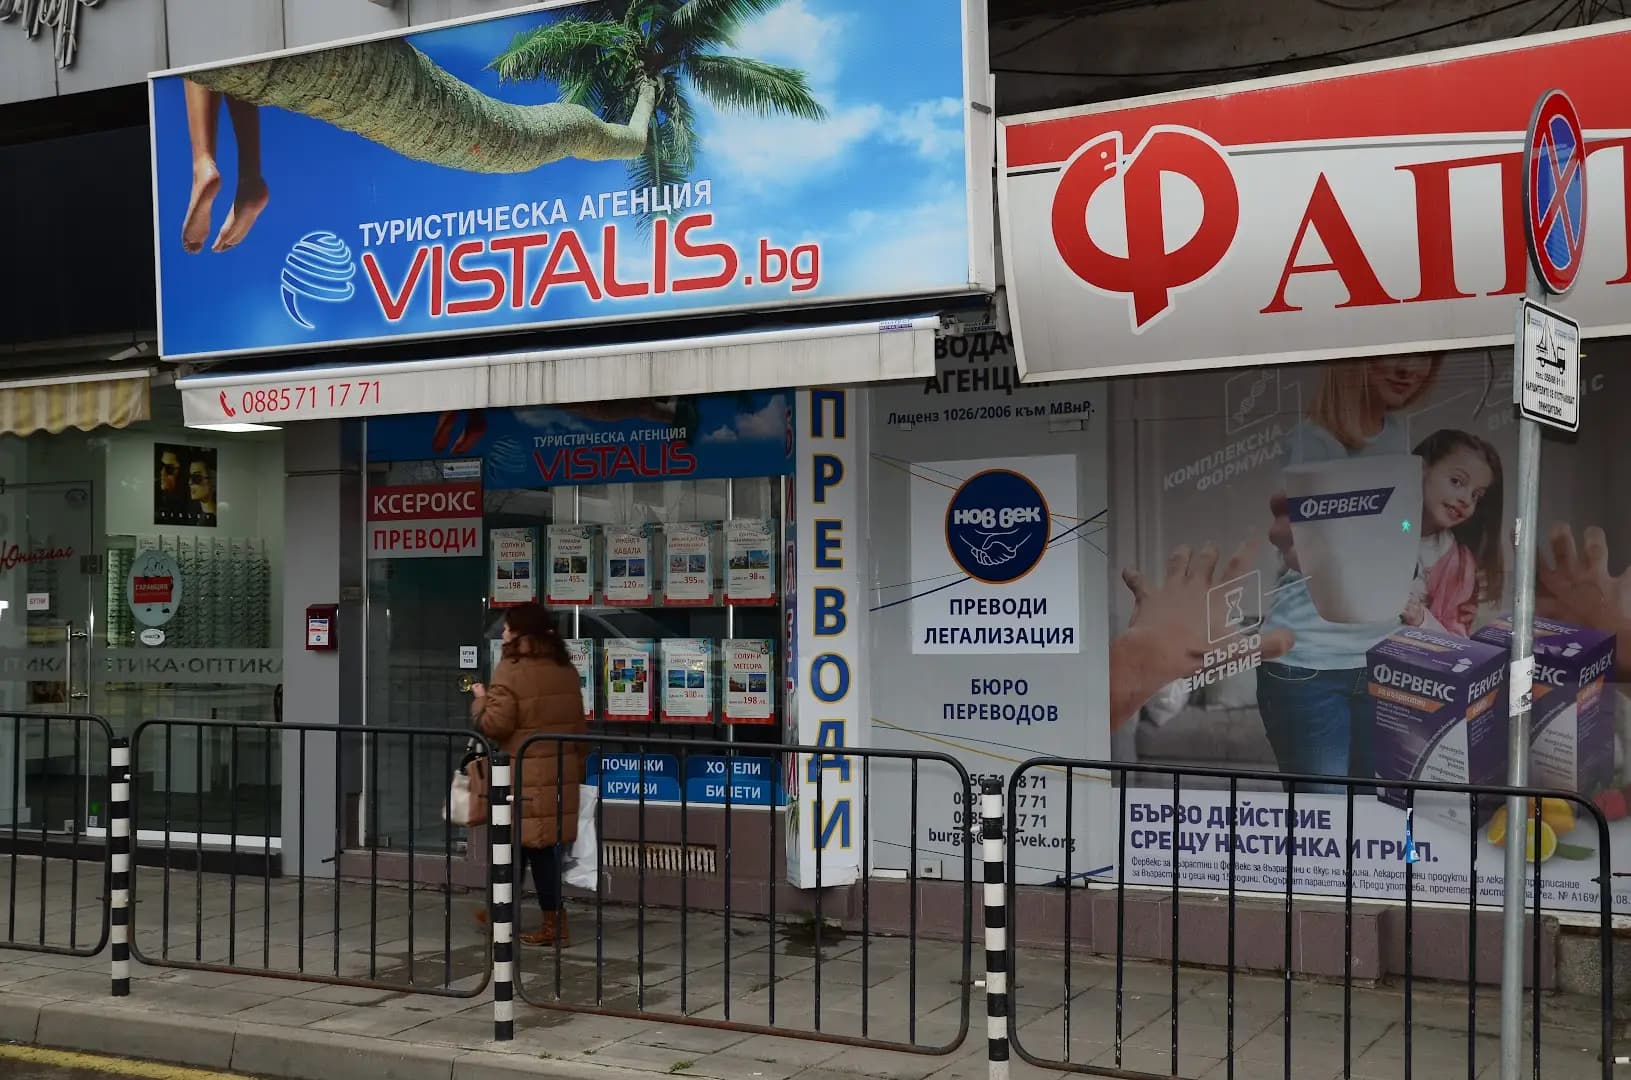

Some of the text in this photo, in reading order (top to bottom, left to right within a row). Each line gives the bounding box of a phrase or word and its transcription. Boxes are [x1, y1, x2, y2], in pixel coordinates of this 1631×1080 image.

[359, 181, 712, 247] ТУРИСТИЧЕСКА АГЕНЦИЯ
[1260, 138, 1631, 314] АП
[924, 365, 1045, 396] АГЕНЦ
[242, 381, 380, 414] 0885 71 17 71
[888, 411, 939, 425] Лиценз
[943, 405, 1011, 420] 1026/2006
[1015, 405, 1046, 418] към
[533, 427, 687, 448] ТУРИСТИЧЕСКА АГЕНЦИЯ
[534, 442, 698, 481] VISTALIS
[1163, 423, 1283, 491] КОМПЛЕКСНА
[1196, 442, 1283, 491] ФОРМУЛА
[373, 490, 477, 515] КСЕРОКС
[1300, 494, 1380, 518] ФЕРВЕКС
[373, 526, 477, 552] ПРЕВОДИ
[807, 388, 852, 850] ПРЕВОДИ
[949, 598, 1048, 619] ПРЕВОДИ
[924, 627, 1075, 648] ЛЕГАЛИЗАЦИЯ
[1202, 633, 1262, 667] БЪРЗО
[970, 679, 1029, 696] БЮРО
[1373, 663, 1457, 702] ФЕРВЕКС
[1467, 663, 1505, 704] FERVEX
[943, 703, 1059, 725] ПЕРЕВОДОВ
